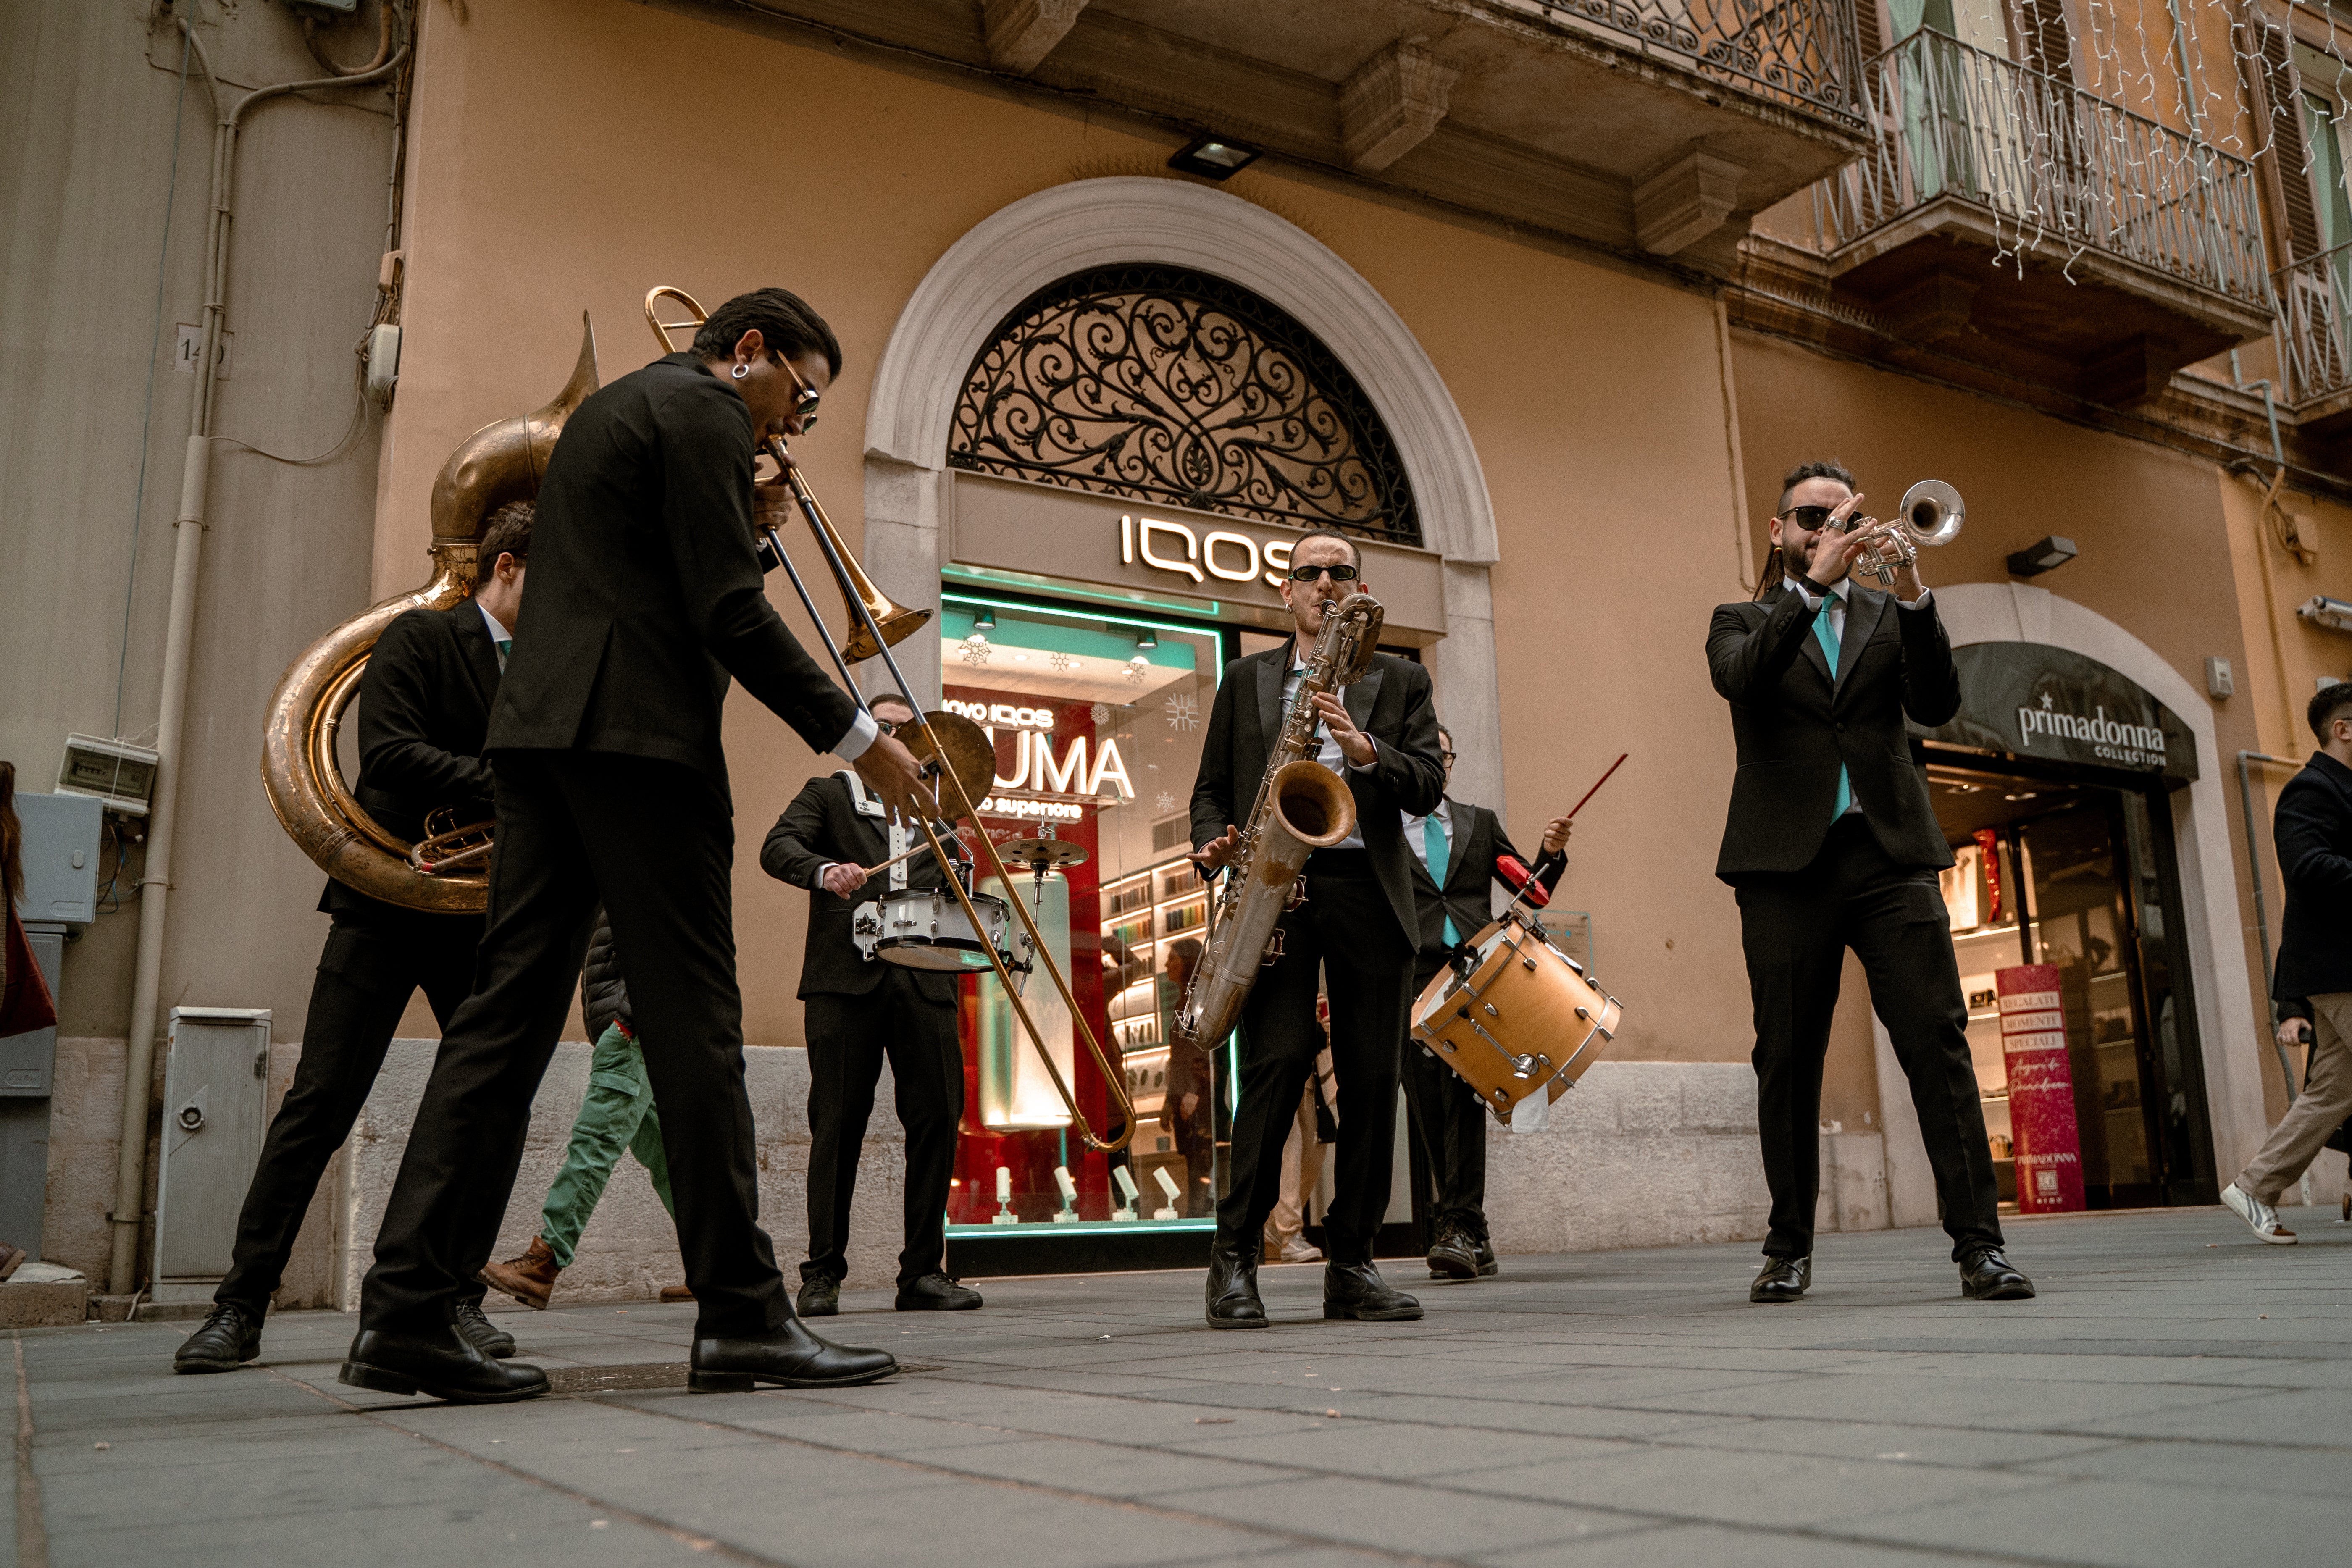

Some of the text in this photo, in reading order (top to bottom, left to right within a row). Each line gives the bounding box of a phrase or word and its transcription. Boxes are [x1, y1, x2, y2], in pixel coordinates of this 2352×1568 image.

[1122, 515, 1296, 587] IQOS
[991, 704, 1054, 728] IQOS
[2018, 697, 2165, 751] primadonna
[2094, 745, 2167, 766] COLLECTION
[996, 798, 1083, 818] superiore
